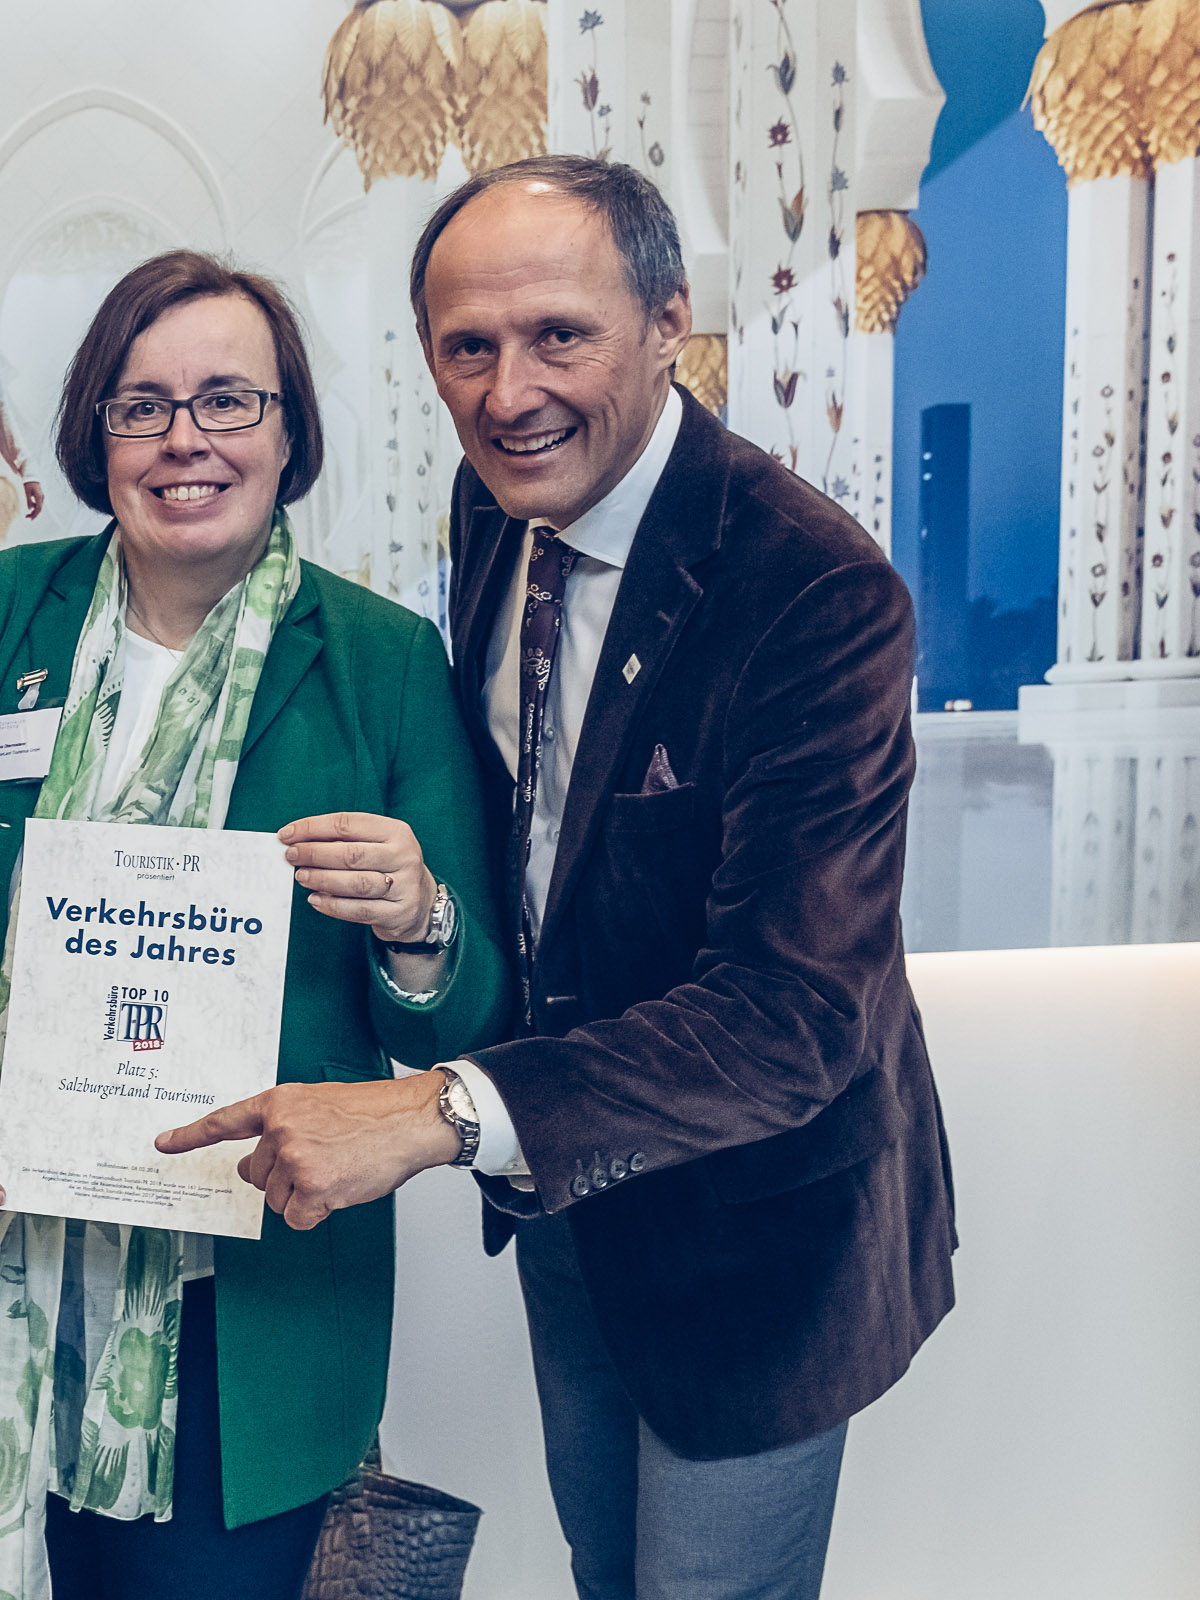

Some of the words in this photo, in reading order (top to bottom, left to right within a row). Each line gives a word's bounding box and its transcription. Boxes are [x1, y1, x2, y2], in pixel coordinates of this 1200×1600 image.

[182, 854, 200, 873] PR
[136, 873, 175, 881] präsentiert
[46, 896, 263, 934] Verkehrsbüro
[66, 929, 117, 956] des
[130, 936, 235, 965] Jahres
[122, 987, 146, 1000] TOP
[154, 990, 169, 1002] 10
[104, 986, 118, 1040] Verkehrsbüro
[134, 1040, 161, 1050] 2018
[117, 1062, 146, 1077] Platz
[148, 1068, 158, 1080] 5:
[59, 1078, 150, 1099] SalzburgerLand
[155, 1088, 215, 1104] Tourismus
